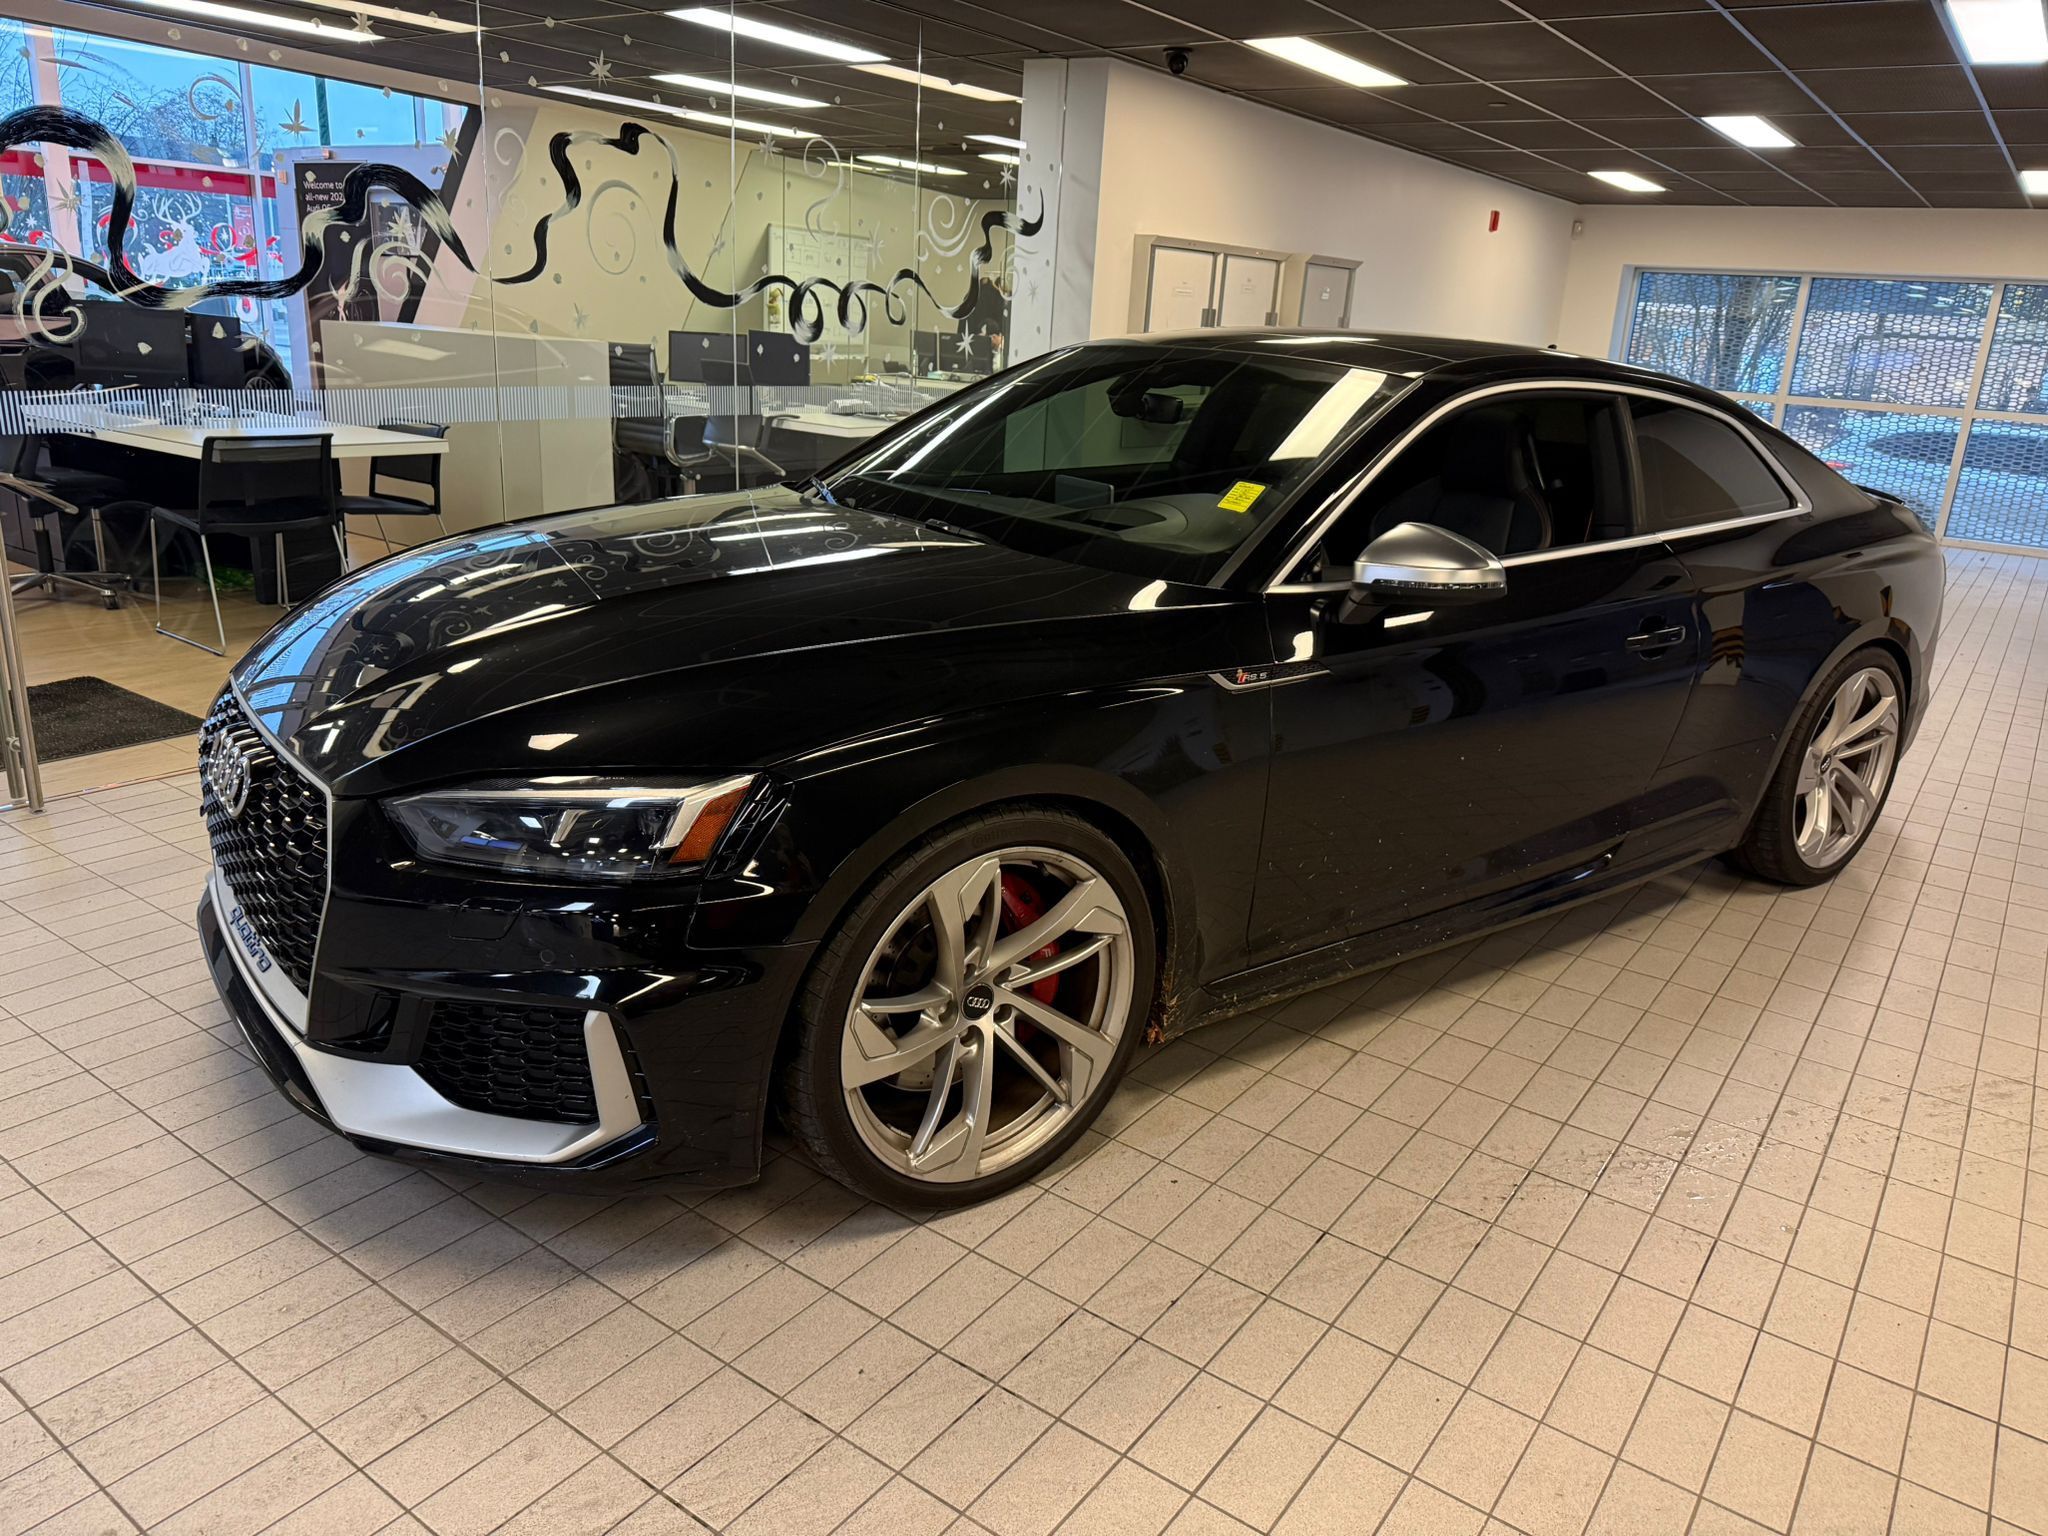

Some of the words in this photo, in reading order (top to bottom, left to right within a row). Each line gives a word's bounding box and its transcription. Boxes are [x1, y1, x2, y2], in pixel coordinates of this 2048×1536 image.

[303, 181, 334, 189] Welcome
[305, 192, 329, 201] all-new
[230, 906, 272, 973] quattro
